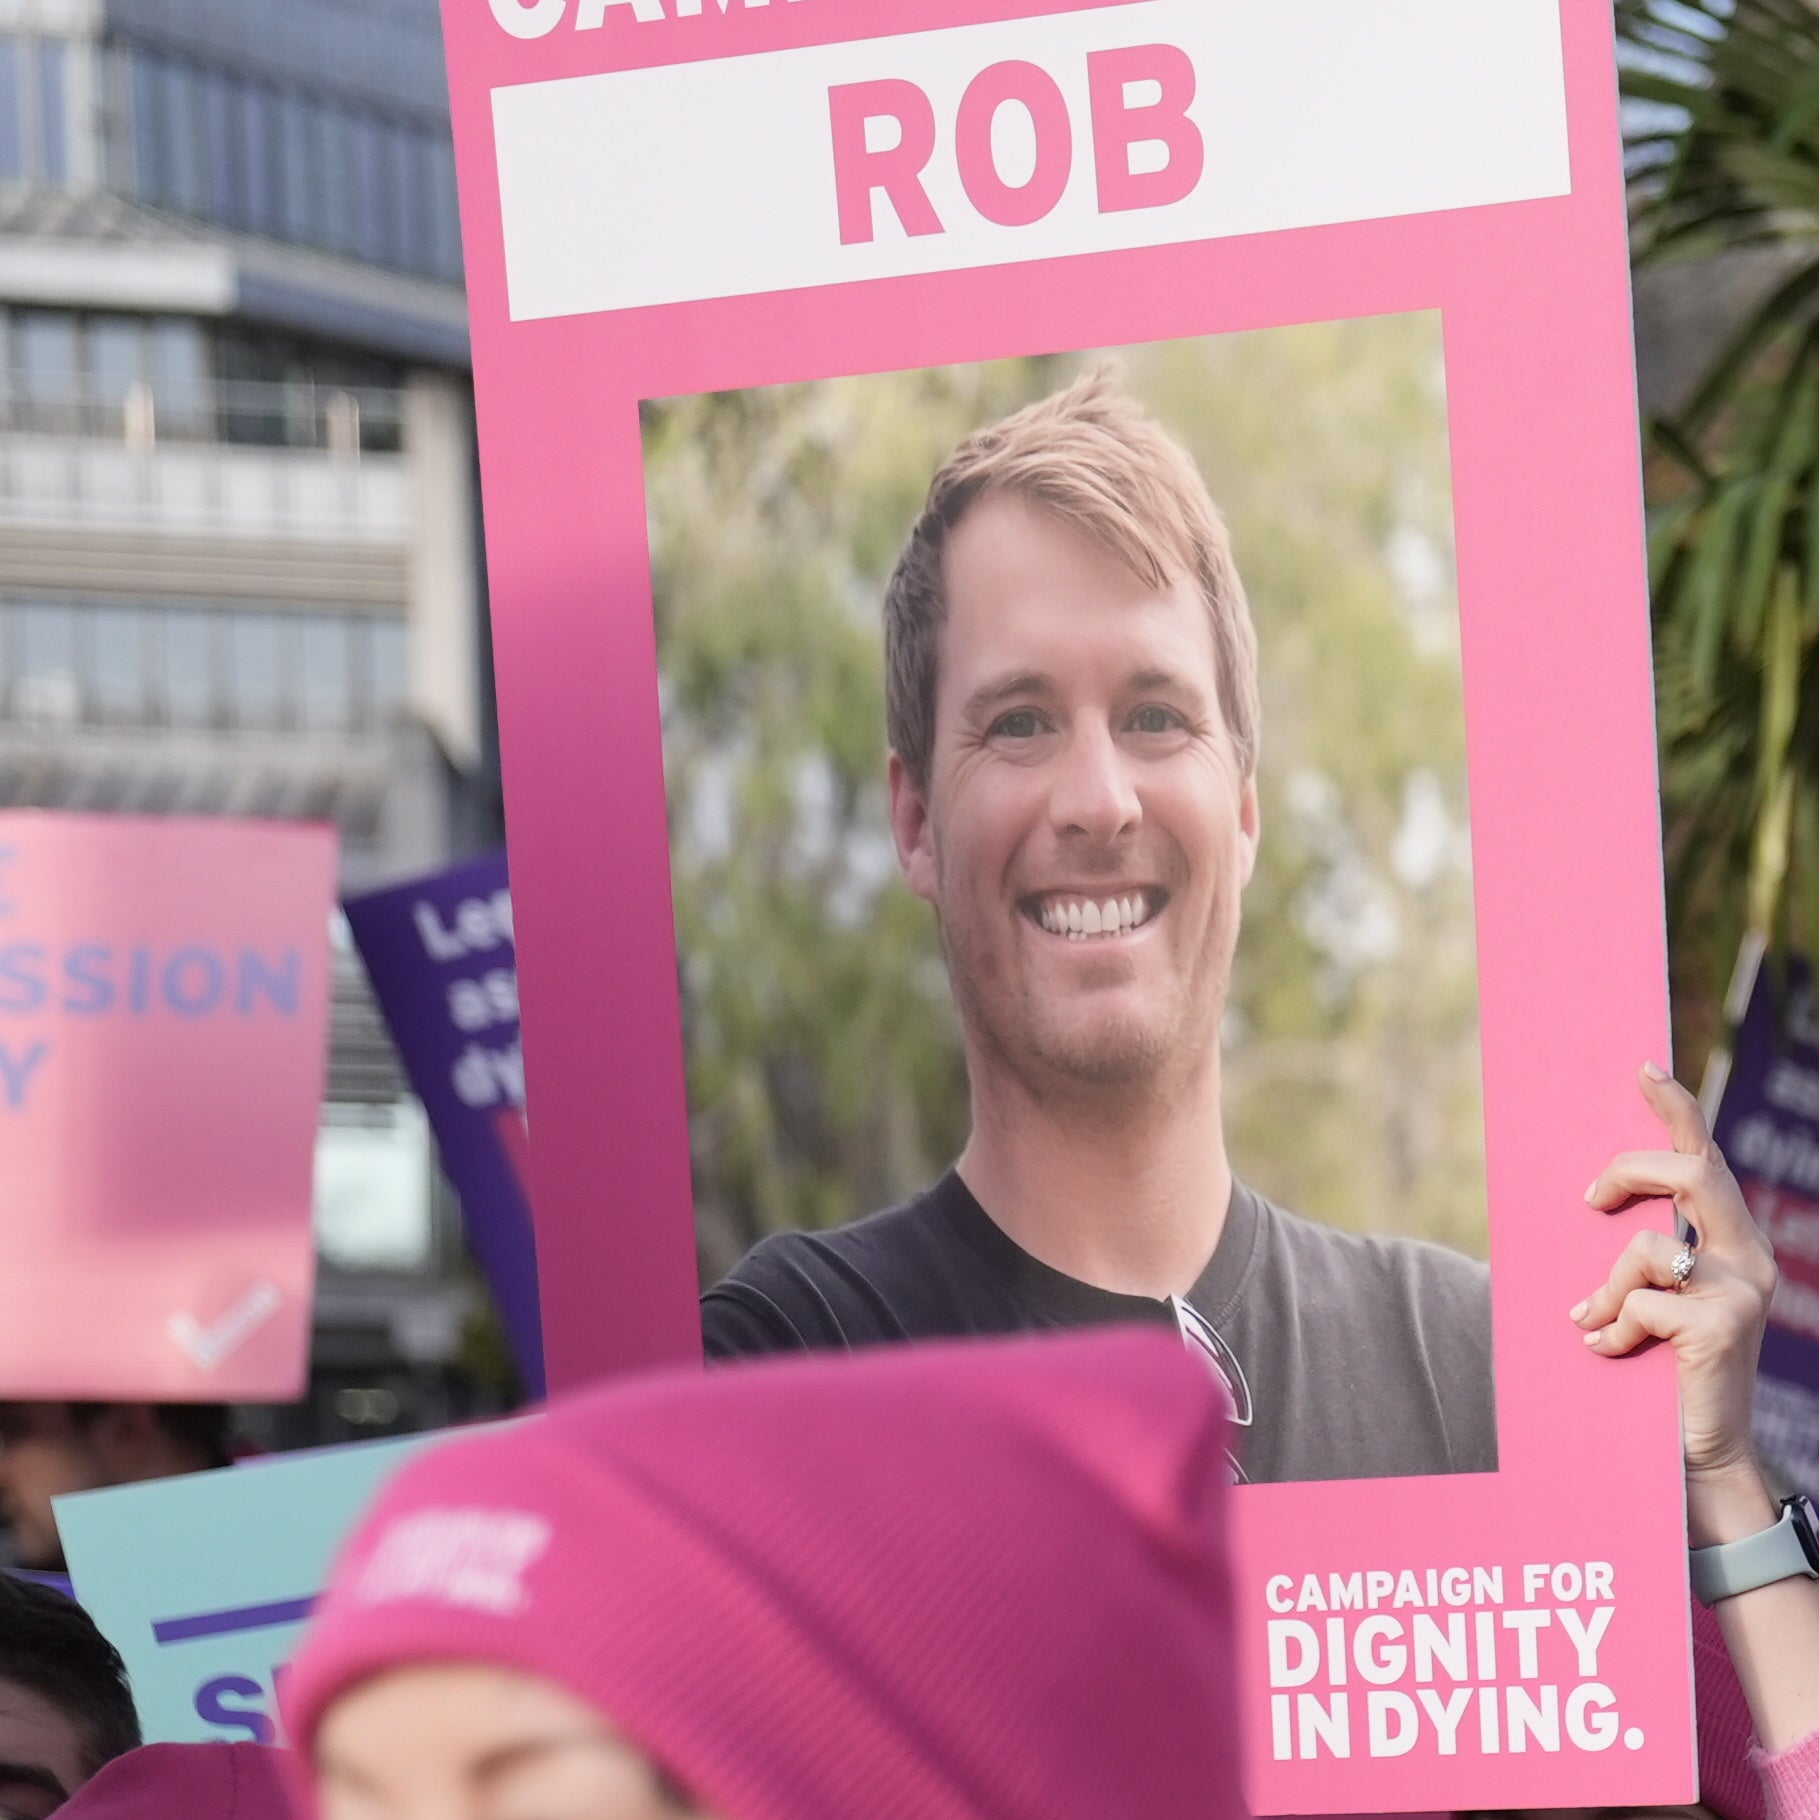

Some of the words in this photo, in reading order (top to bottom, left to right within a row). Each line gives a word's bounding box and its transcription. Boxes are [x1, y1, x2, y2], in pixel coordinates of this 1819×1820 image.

[826, 43, 1205, 246] ROB
[1265, 1566, 1504, 1613] CAMPAIGN
[1522, 1561, 1616, 1603] FOR
[1266, 1606, 1616, 1688] DIGNITY
[1271, 1692, 1351, 1761] IN
[1367, 1682, 1646, 1759] DYING.
